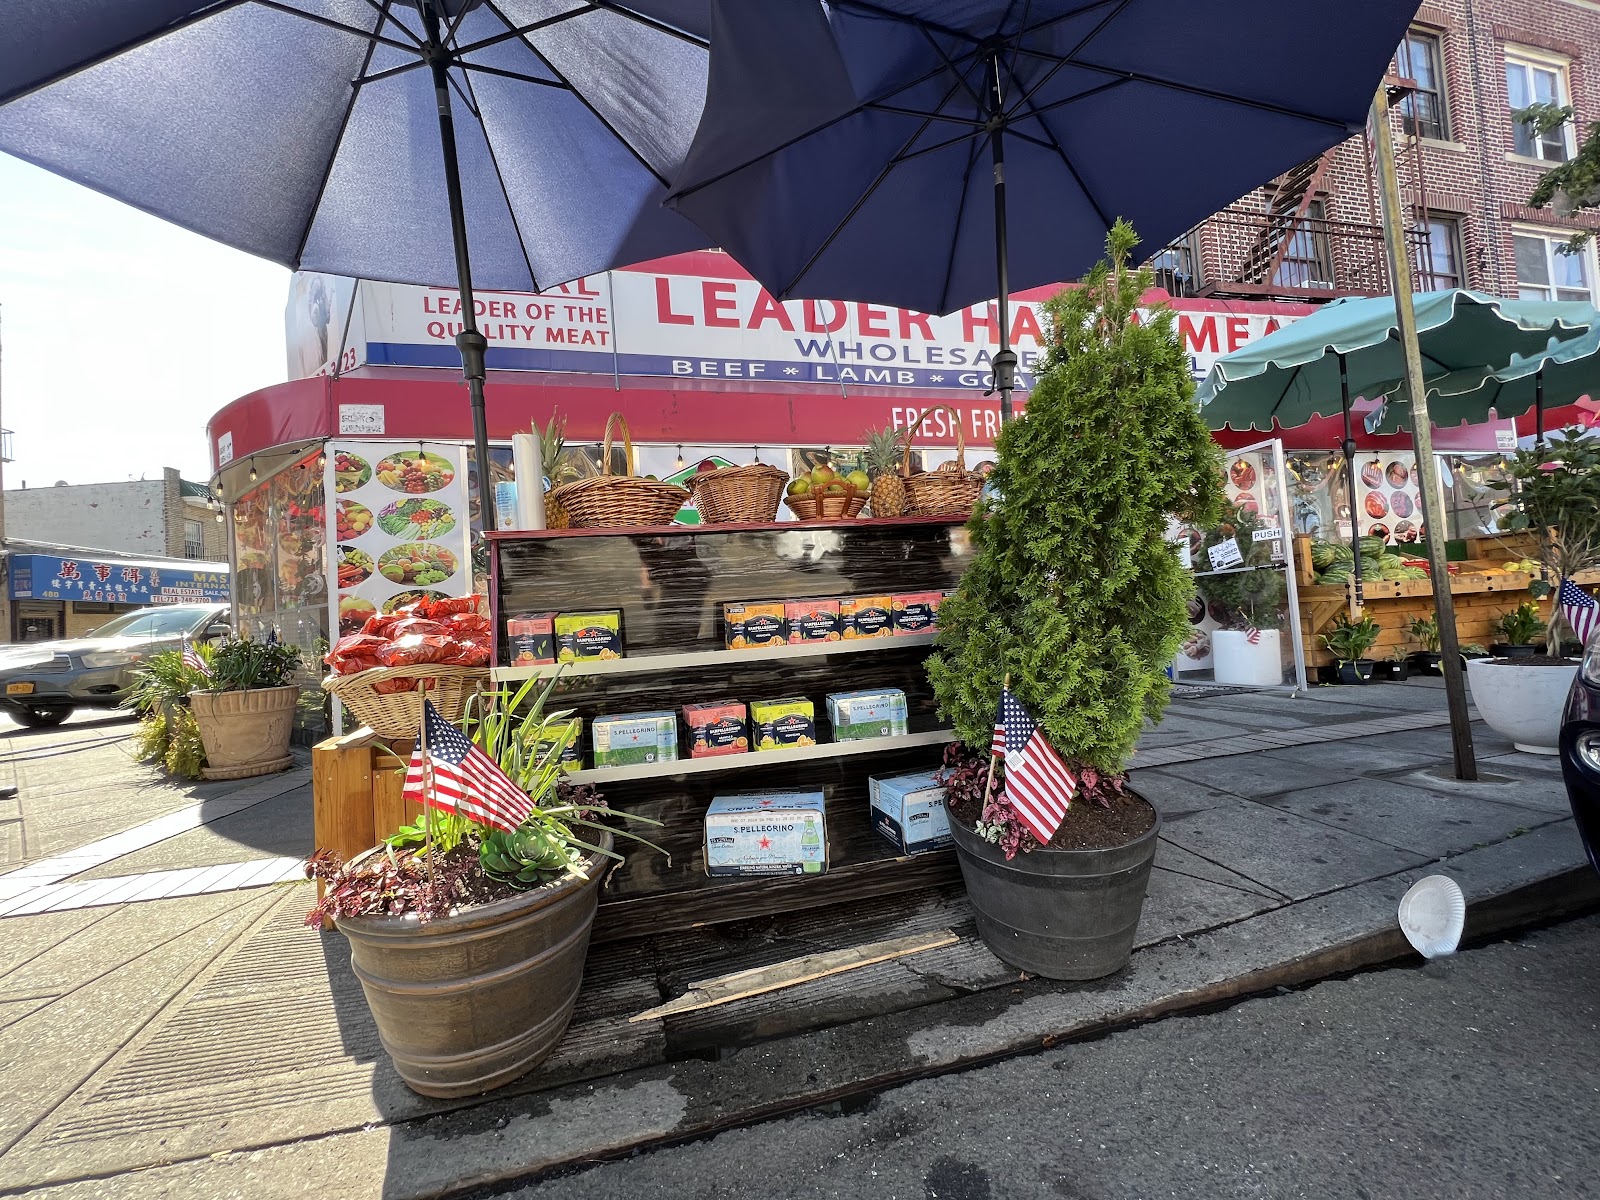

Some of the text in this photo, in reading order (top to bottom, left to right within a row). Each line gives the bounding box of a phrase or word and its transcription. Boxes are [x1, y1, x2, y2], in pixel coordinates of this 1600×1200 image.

[423, 296, 608, 324] LEADER OF THE
[655, 277, 936, 340] LEADER
[426, 321, 610, 346] QULITY MEAT
[793, 338, 1037, 367] WHOLESAE
[672, 360, 766, 377] BEEF
[816, 365, 915, 384] LAMB
[891, 407, 962, 438] FRESH
[1254, 530, 1280, 539] PUSH
[175, 580, 229, 589] INTERNAT
[193, 572, 229, 584] MAS
[180, 588, 202, 596] ESTATE
[613, 727, 655, 736] S.PELLEGRINO
[733, 824, 793, 833] S.PELLEGRINO
